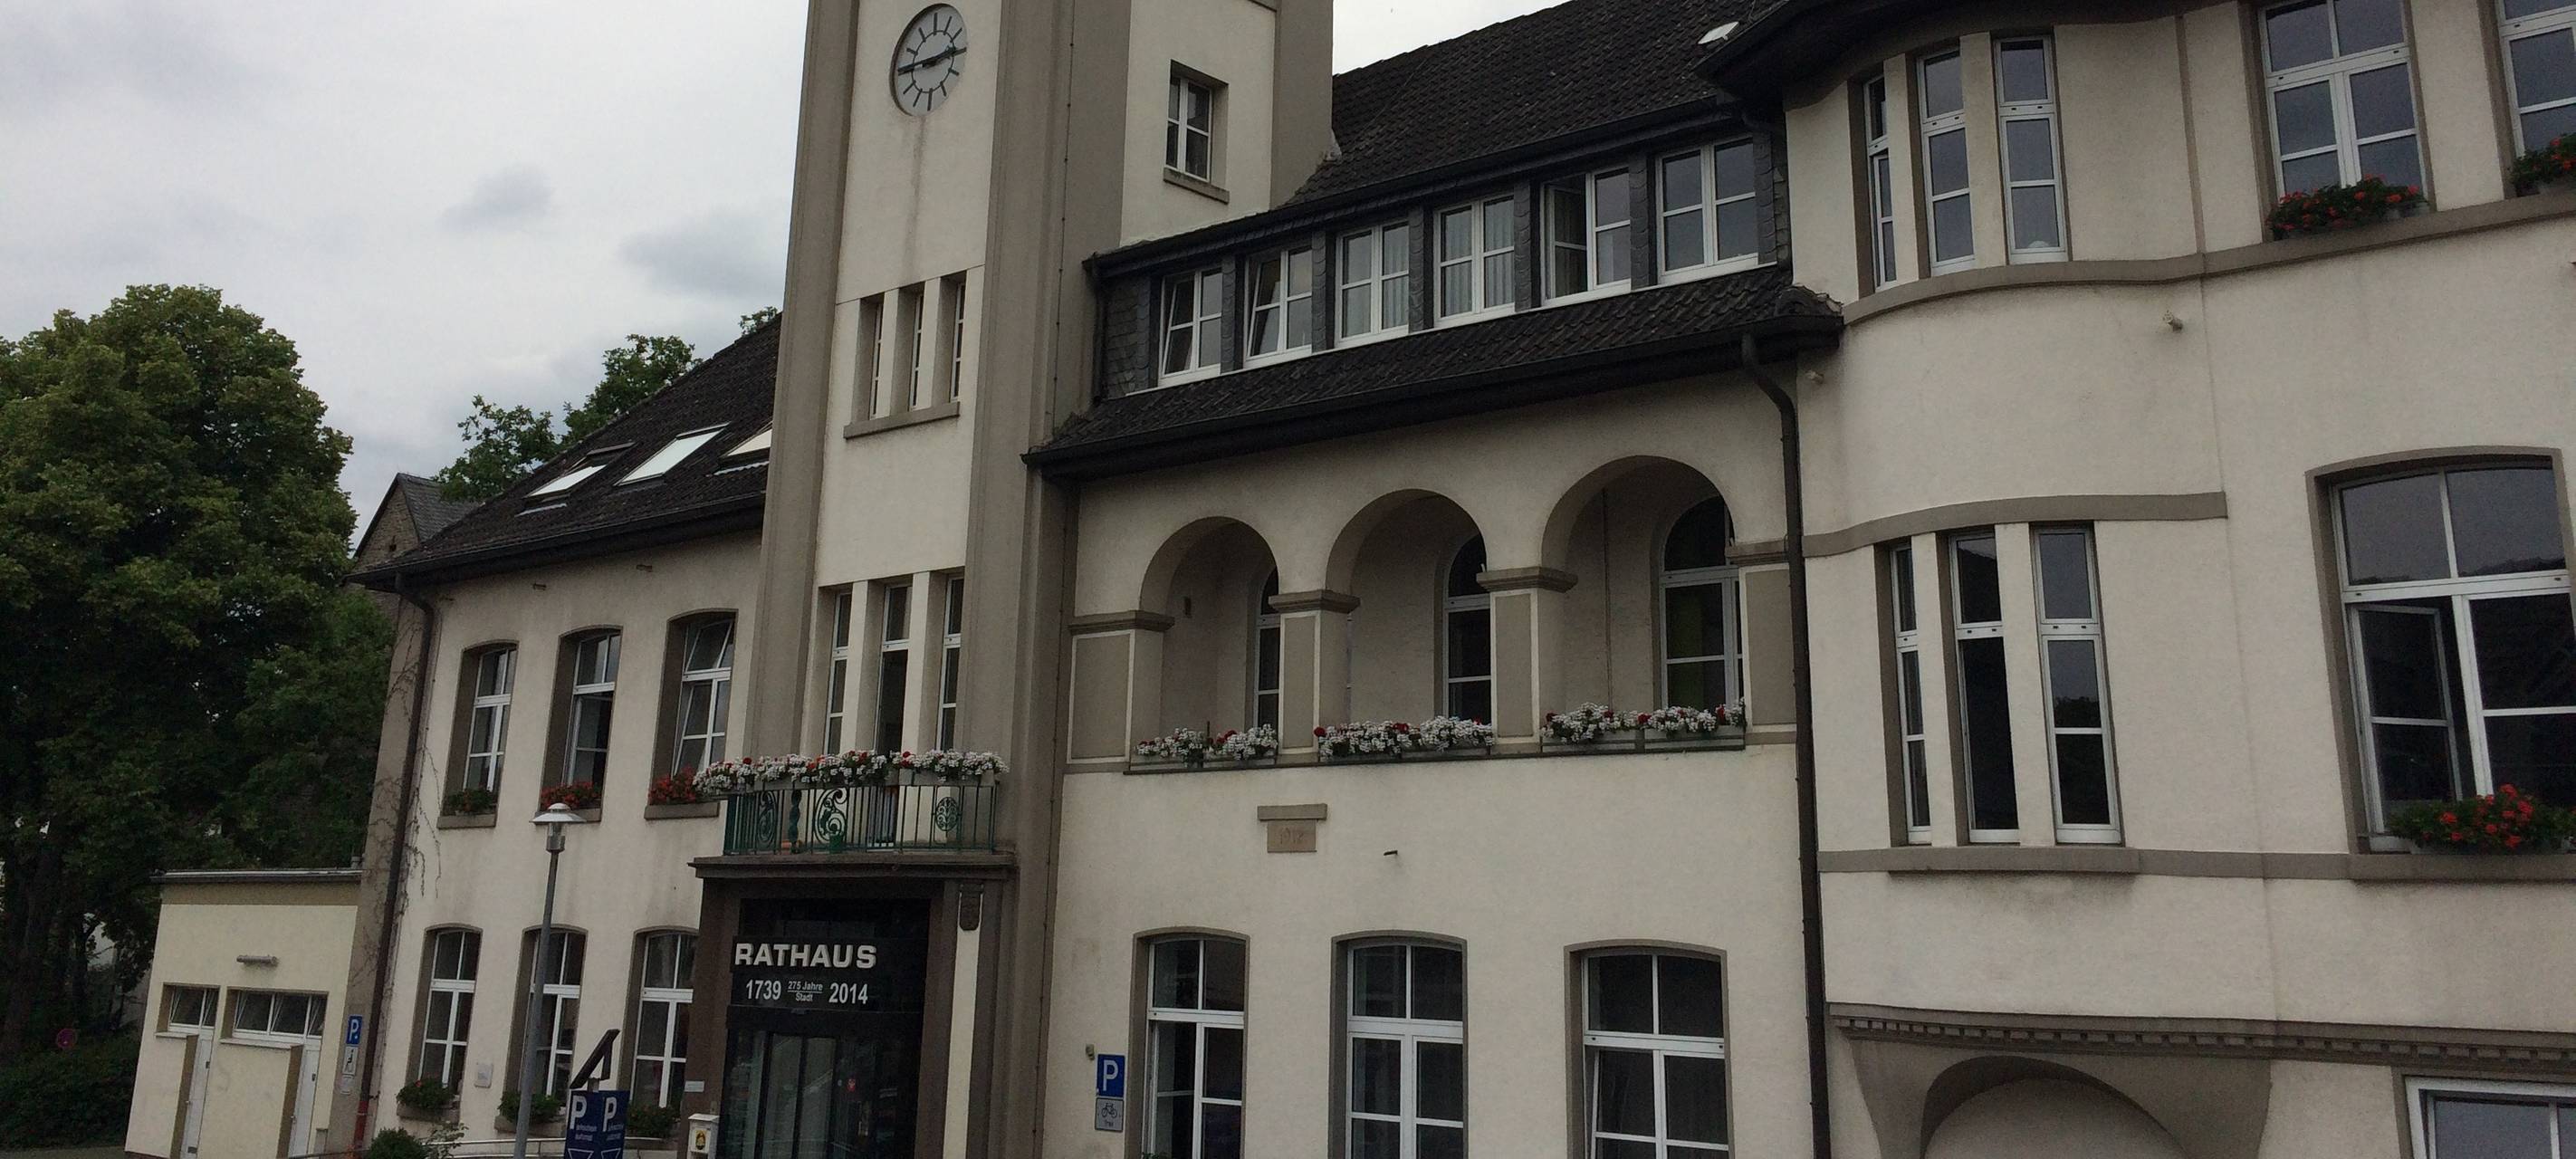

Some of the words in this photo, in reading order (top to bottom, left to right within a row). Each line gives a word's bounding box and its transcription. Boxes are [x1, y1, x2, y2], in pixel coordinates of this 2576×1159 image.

[734, 943, 877, 969] RATHAUS
[746, 979, 782, 1001] 1739
[788, 981, 801, 990] 275
[801, 981, 823, 991] Jahre
[795, 992, 813, 1002] Stadt
[828, 982, 868, 1005] 2014
[1102, 1059, 1119, 1091] P
[570, 1095, 587, 1130] P
[603, 1097, 618, 1132] P
